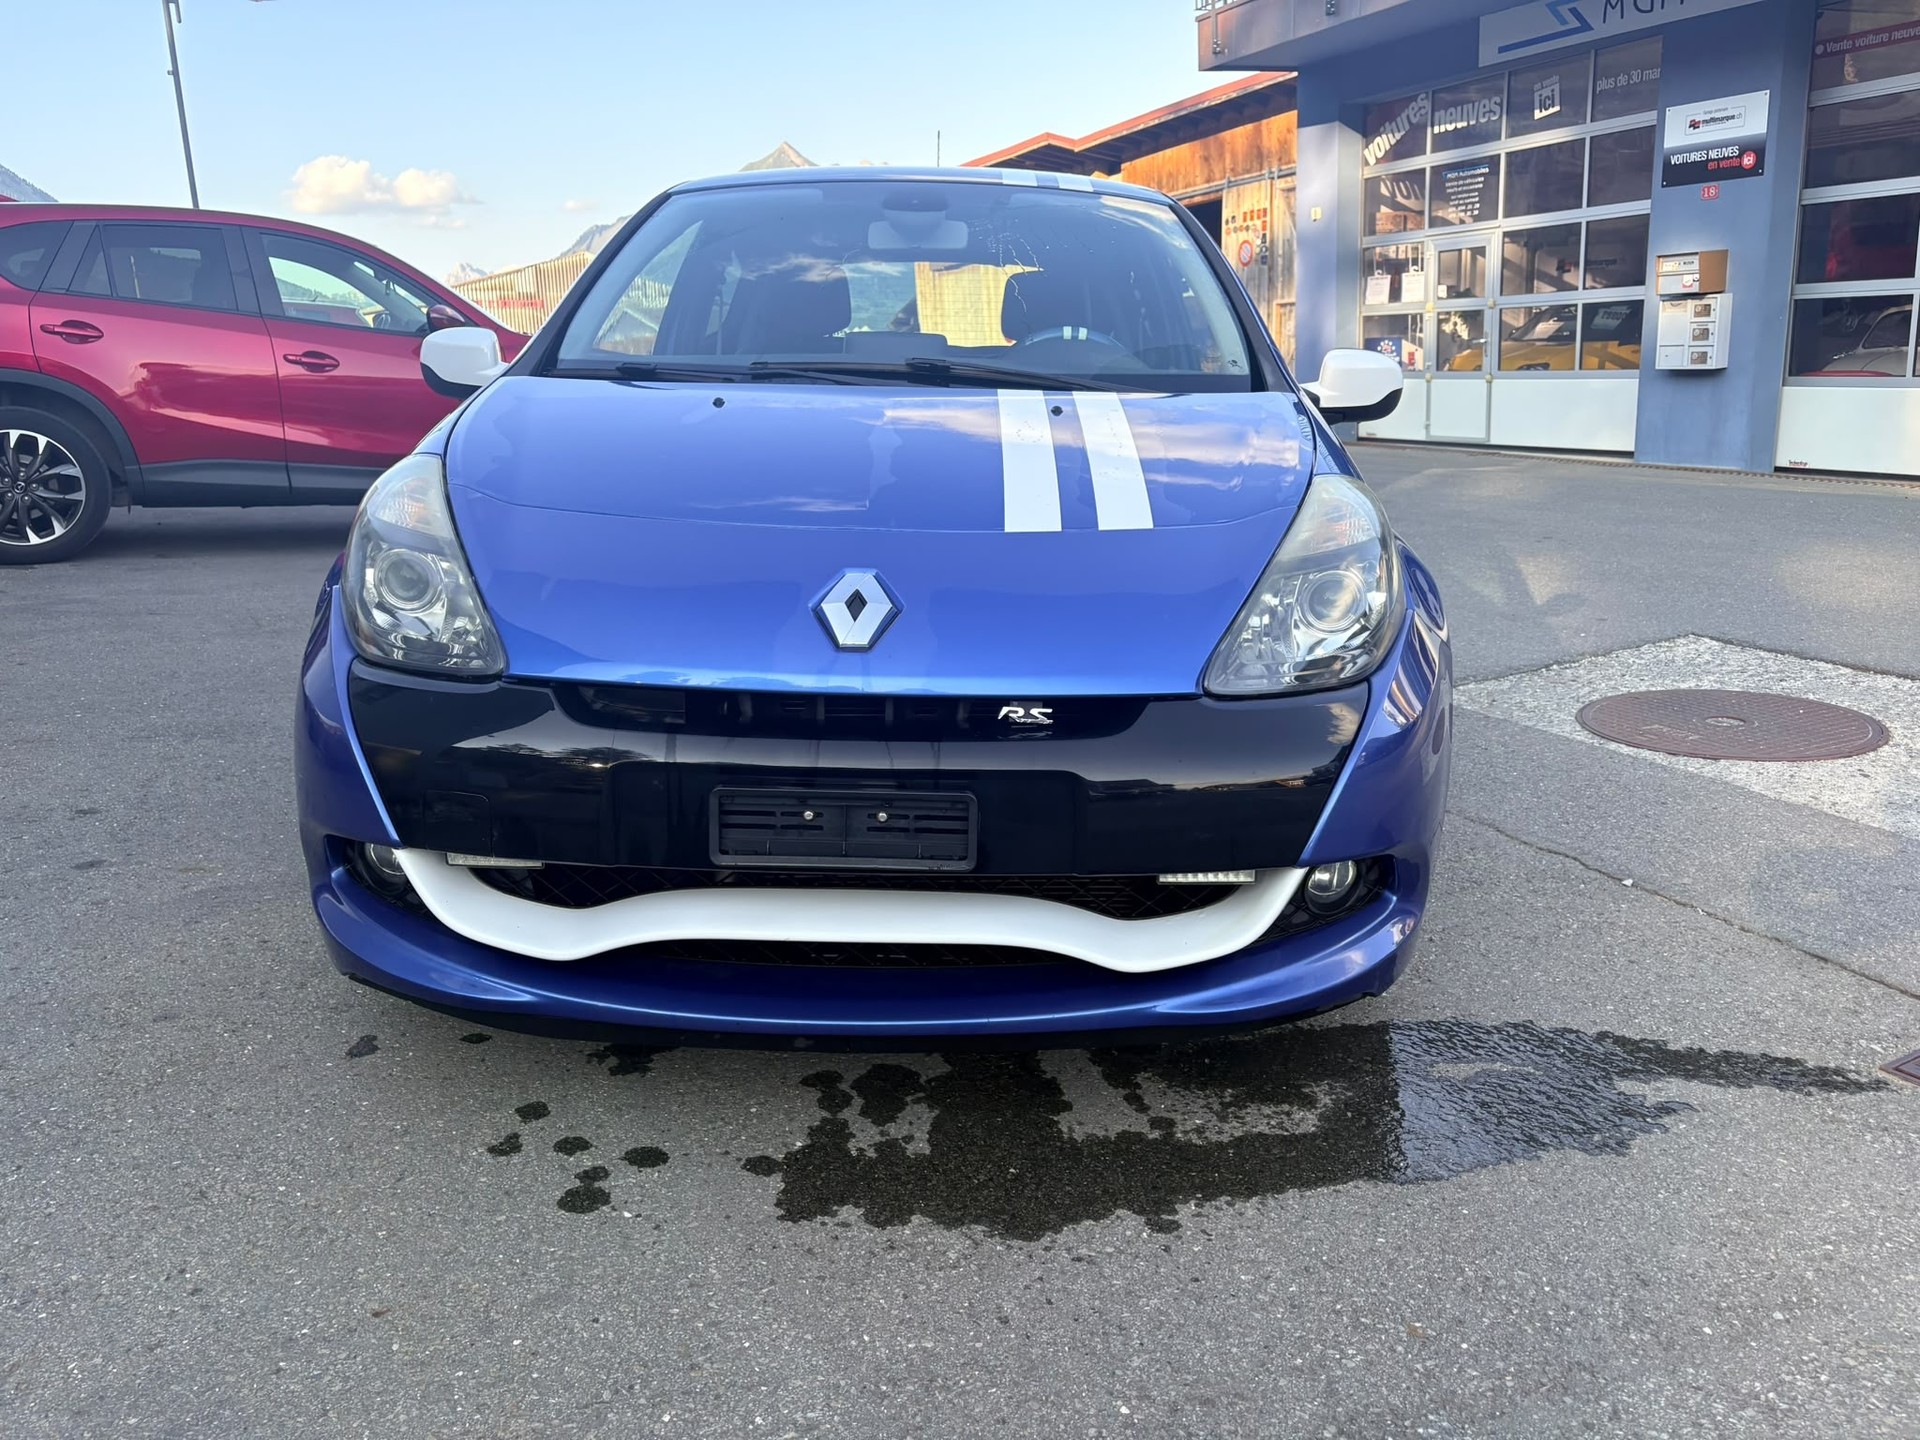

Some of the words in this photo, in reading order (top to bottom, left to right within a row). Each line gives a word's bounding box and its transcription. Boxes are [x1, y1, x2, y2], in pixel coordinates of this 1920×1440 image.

[1826, 39, 1853, 53] Vente
[1854, 33, 1889, 47] voiture
[1596, 77, 1615, 94] plus
[1617, 73, 1628, 86] de
[1629, 69, 1641, 83] 30
[1538, 88, 1556, 113] ici
[1363, 93, 1429, 166] voitures
[1433, 96, 1501, 135] neuves
[1670, 150, 1707, 165] VOITURES
[1708, 146, 1739, 159] NEUVES
[1707, 162, 1718, 170] en
[1719, 157, 1740, 168] vente
[1743, 153, 1753, 165] ici
[1703, 186, 1716, 198] 18
